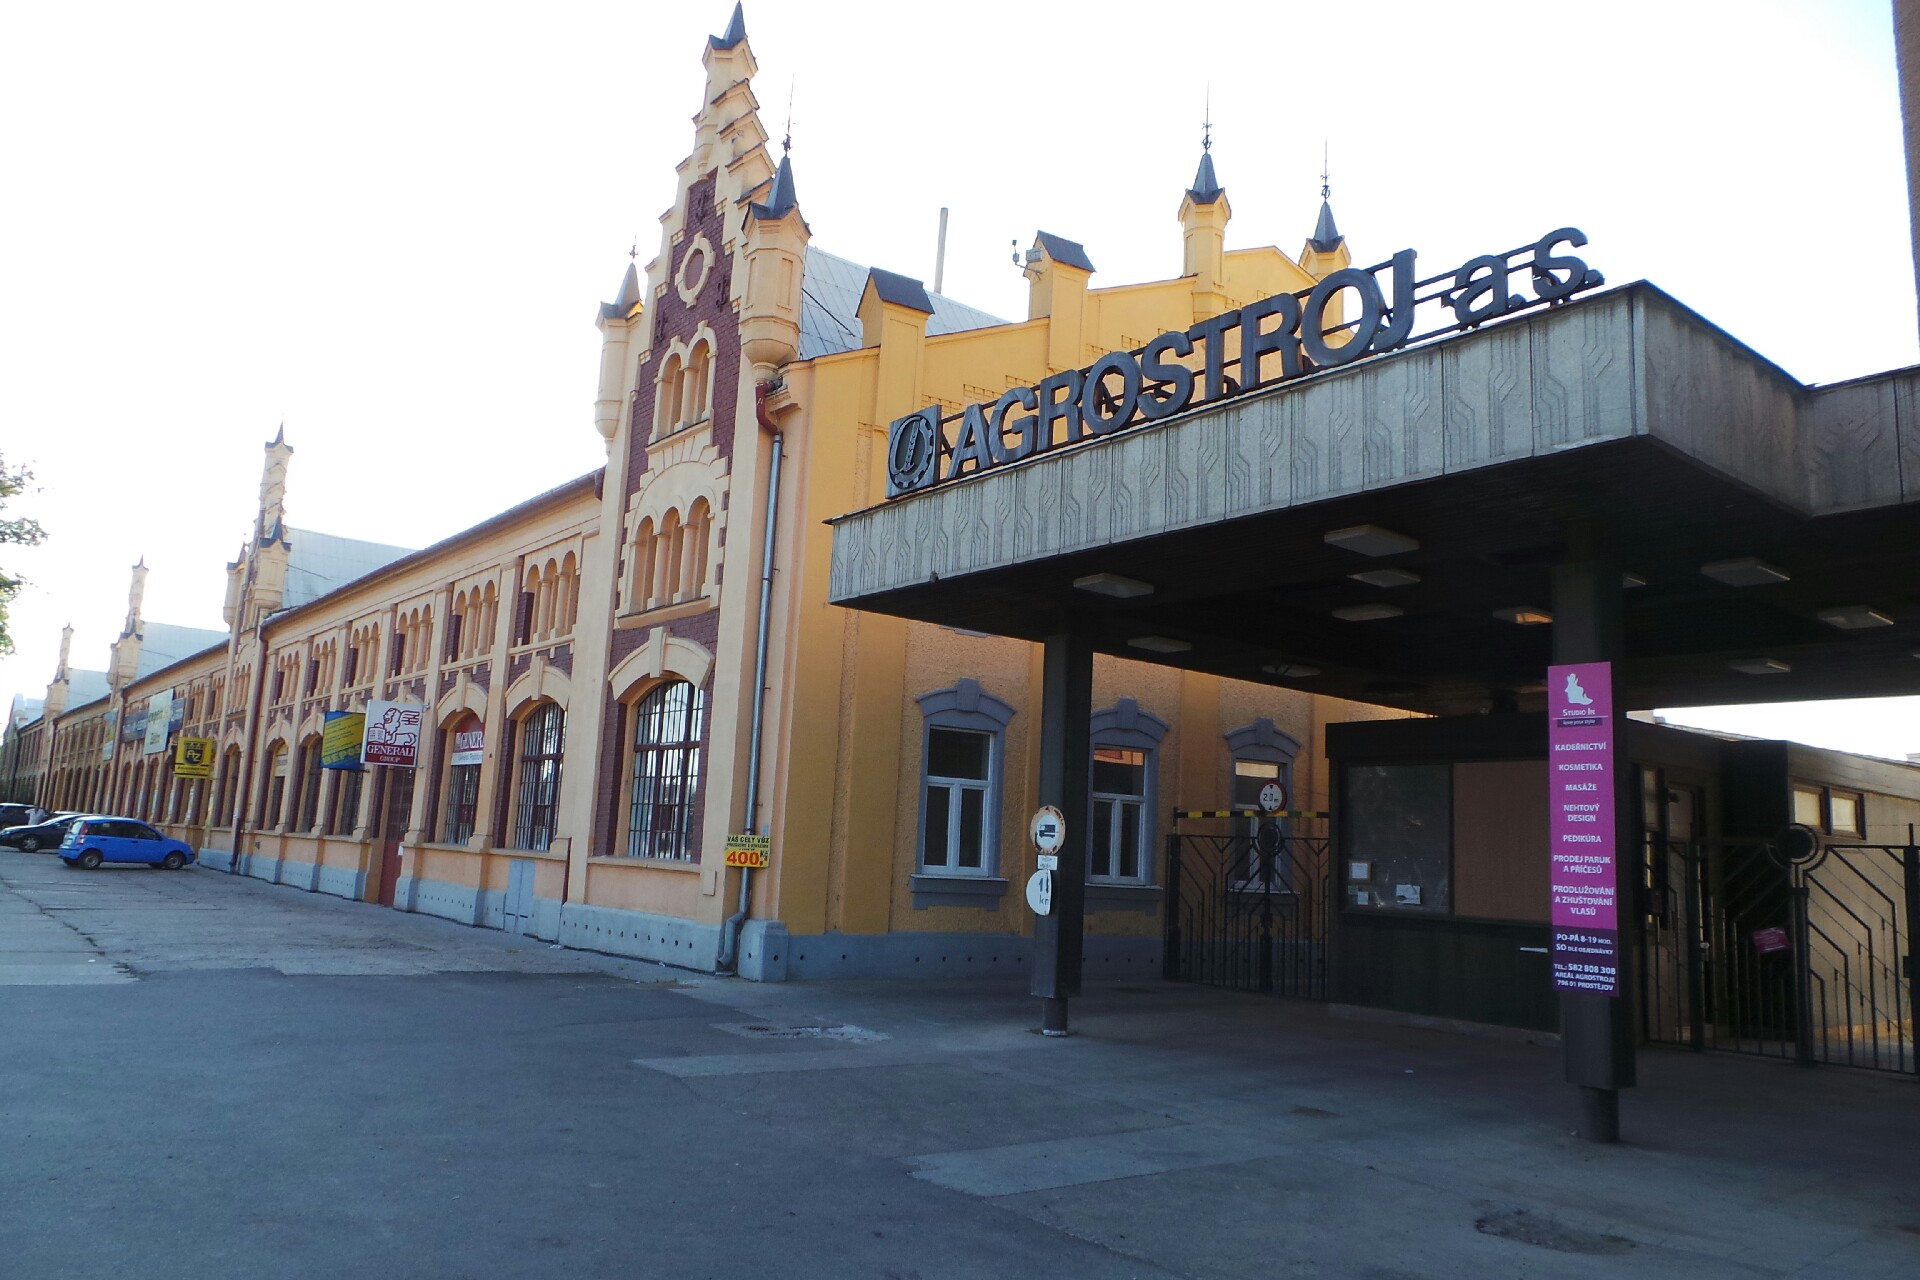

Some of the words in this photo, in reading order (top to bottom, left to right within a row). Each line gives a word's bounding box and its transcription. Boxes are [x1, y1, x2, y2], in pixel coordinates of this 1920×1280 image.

[946, 248, 1417, 479] AGROSTROJ
[1453, 227, 1605, 327] a.s.
[367, 744, 414, 756] GENERALI
[1555, 742, 1606, 751] KADEŘNICTVÍ
[1565, 783, 1597, 791] MASÁŽE
[1564, 803, 1600, 812] NEHTOVÝ
[1563, 834, 1602, 842] PEDIKÚRA
[1554, 854, 1584, 862] PRODEJ
[1584, 856, 1610, 864] PARUK
[1570, 865, 1602, 874] PŘÍČESŮ
[1552, 885, 1614, 896] PRODLUŽOVÁNÍ
[1570, 907, 1596, 916] VLASŮ
[1556, 934, 1579, 942] PO-PÁ
[1580, 936, 1597, 944] 8-19
[1568, 964, 1583, 972] 582
[1578, 981, 1614, 990] PROSTĚJOV
